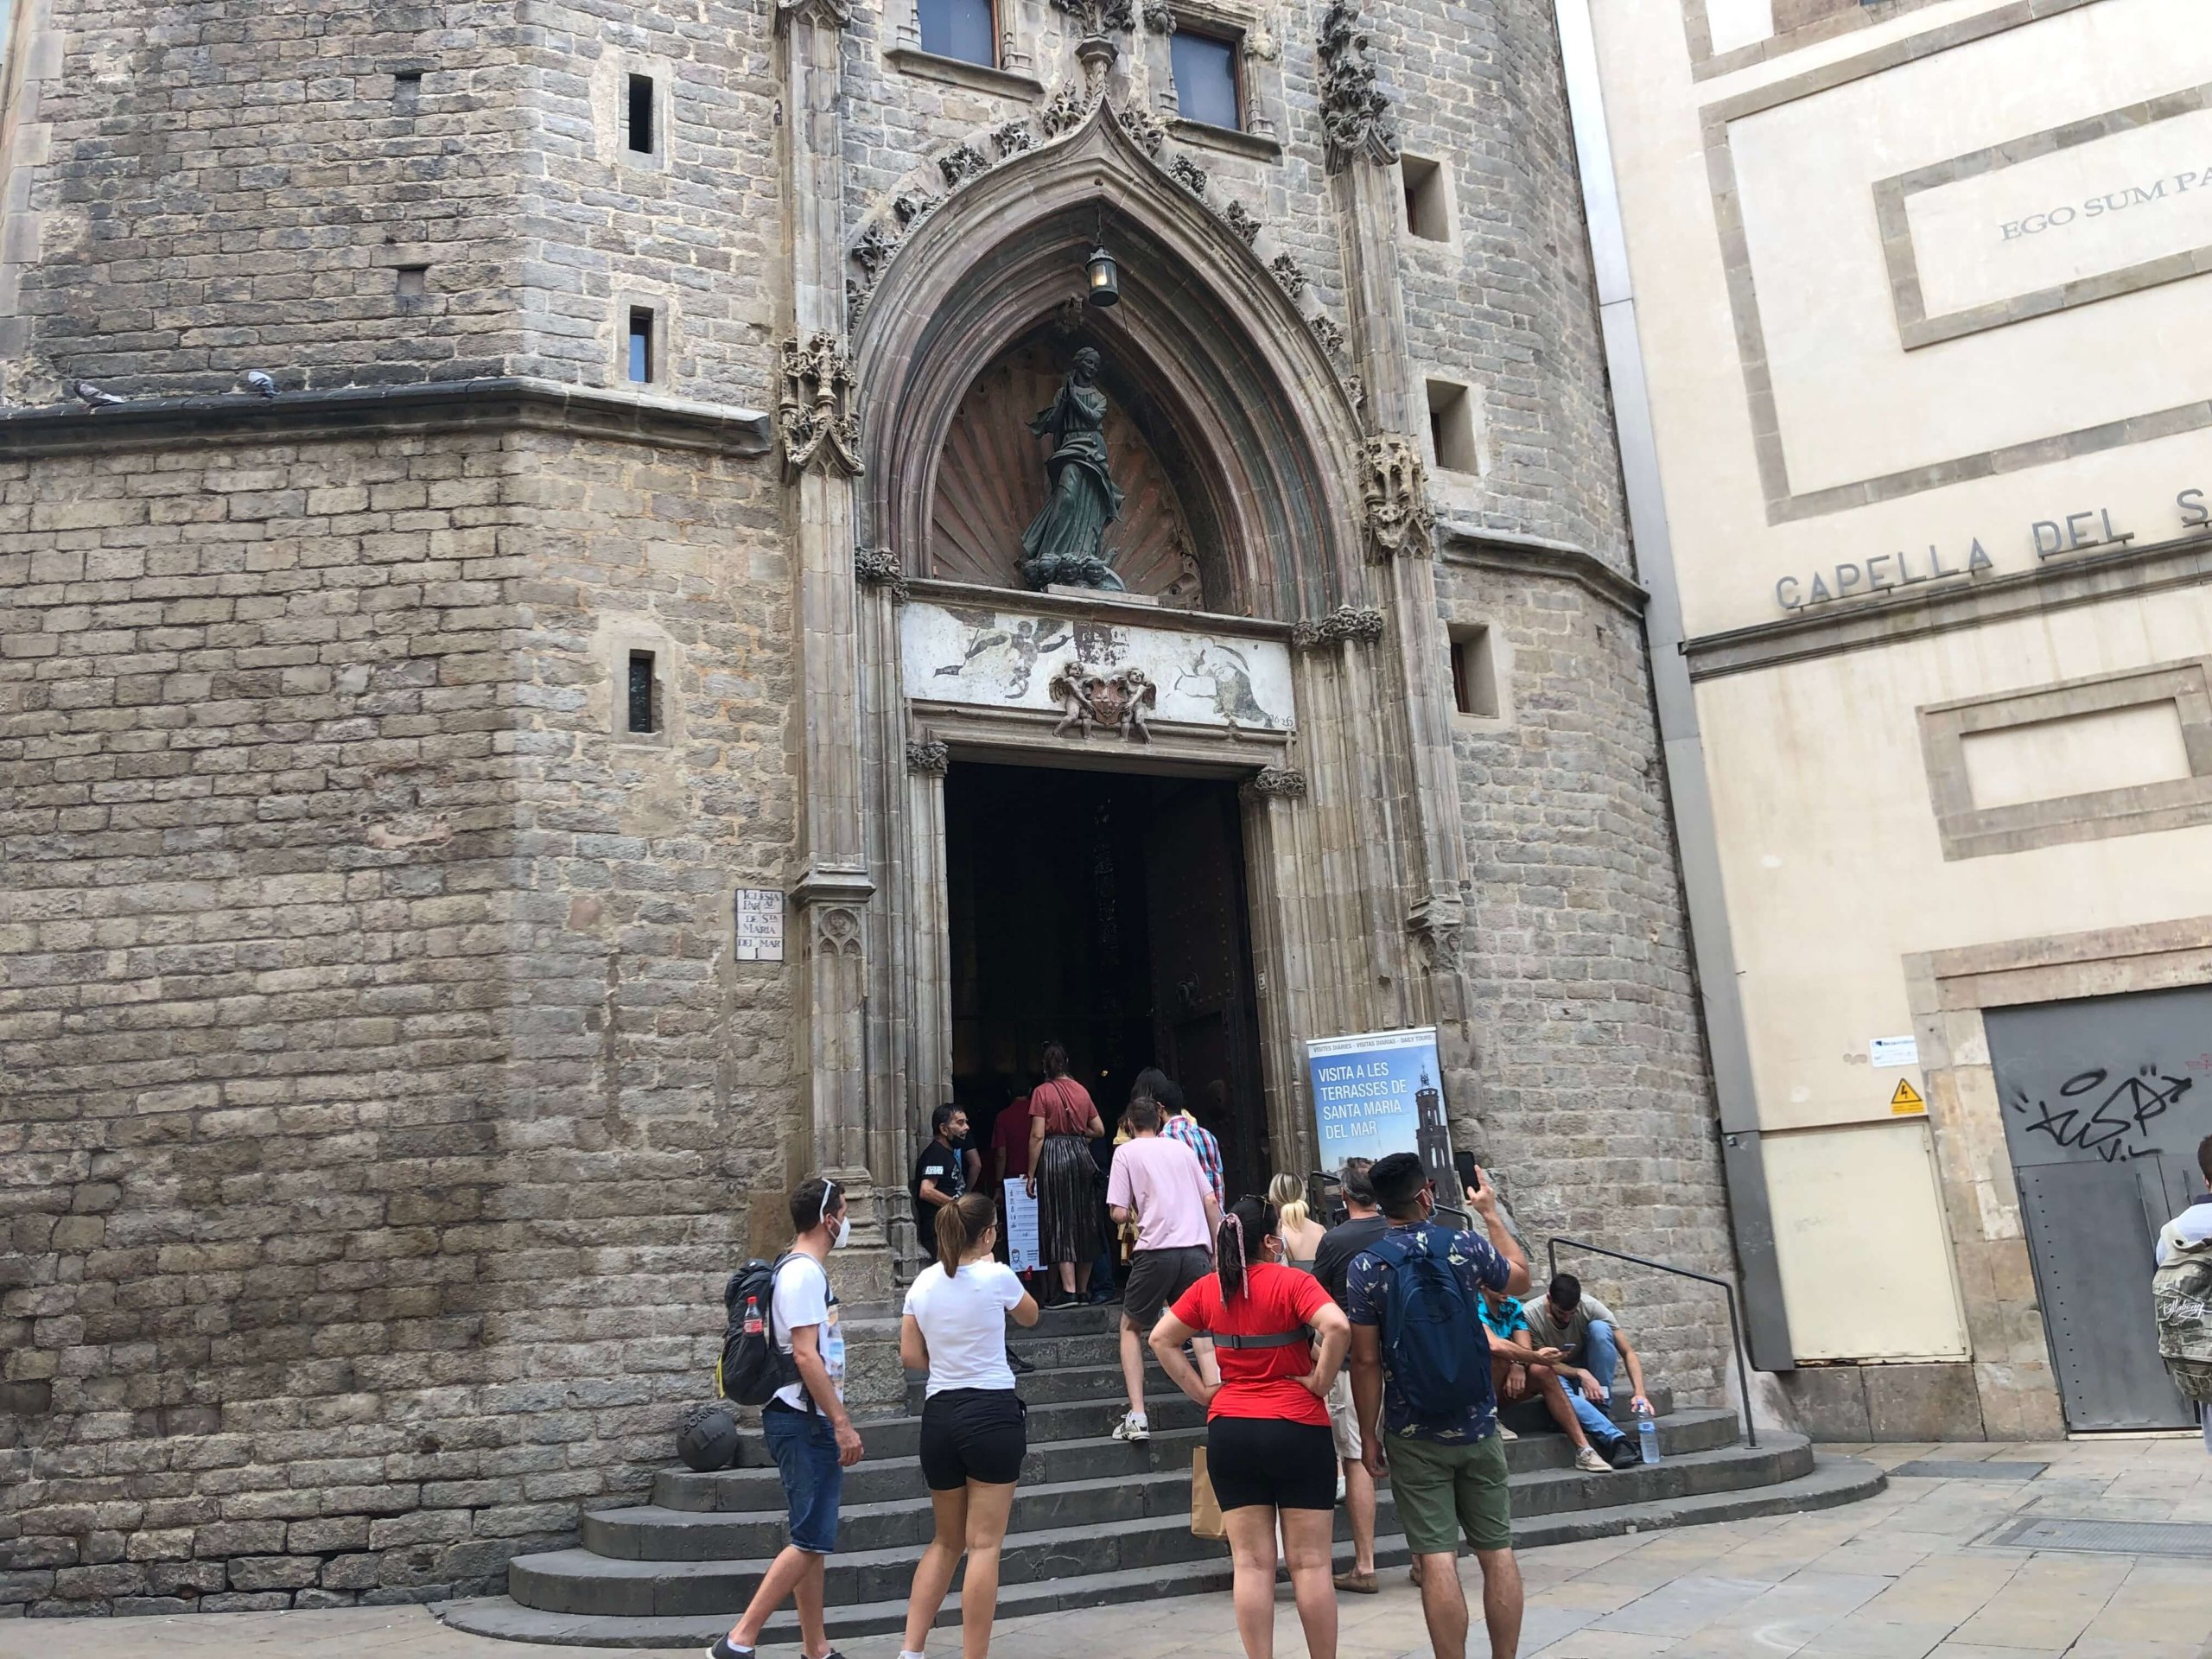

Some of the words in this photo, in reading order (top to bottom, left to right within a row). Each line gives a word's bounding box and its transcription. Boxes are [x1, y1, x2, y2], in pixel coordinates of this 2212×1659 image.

[1999, 206, 2076, 241] EGO
[2083, 179, 2169, 217] SUM
[1775, 536, 1993, 610] CAPELLA
[2031, 508, 2134, 560] DEL
[1376, 1038, 1396, 1046] DIARIAS
[1318, 1065, 1355, 1083] VISITA
[1357, 1064, 1365, 1078] A
[1367, 1061, 1389, 1077] LES
[1320, 1080, 1389, 1102] TERRASSES
[1391, 1078, 1408, 1094] DE
[1323, 1103, 1362, 1121] SANTA
[1363, 1098, 1402, 1116] MARIA
[1325, 1124, 1348, 1140] DEL
[1351, 1120, 1377, 1137] MAR
